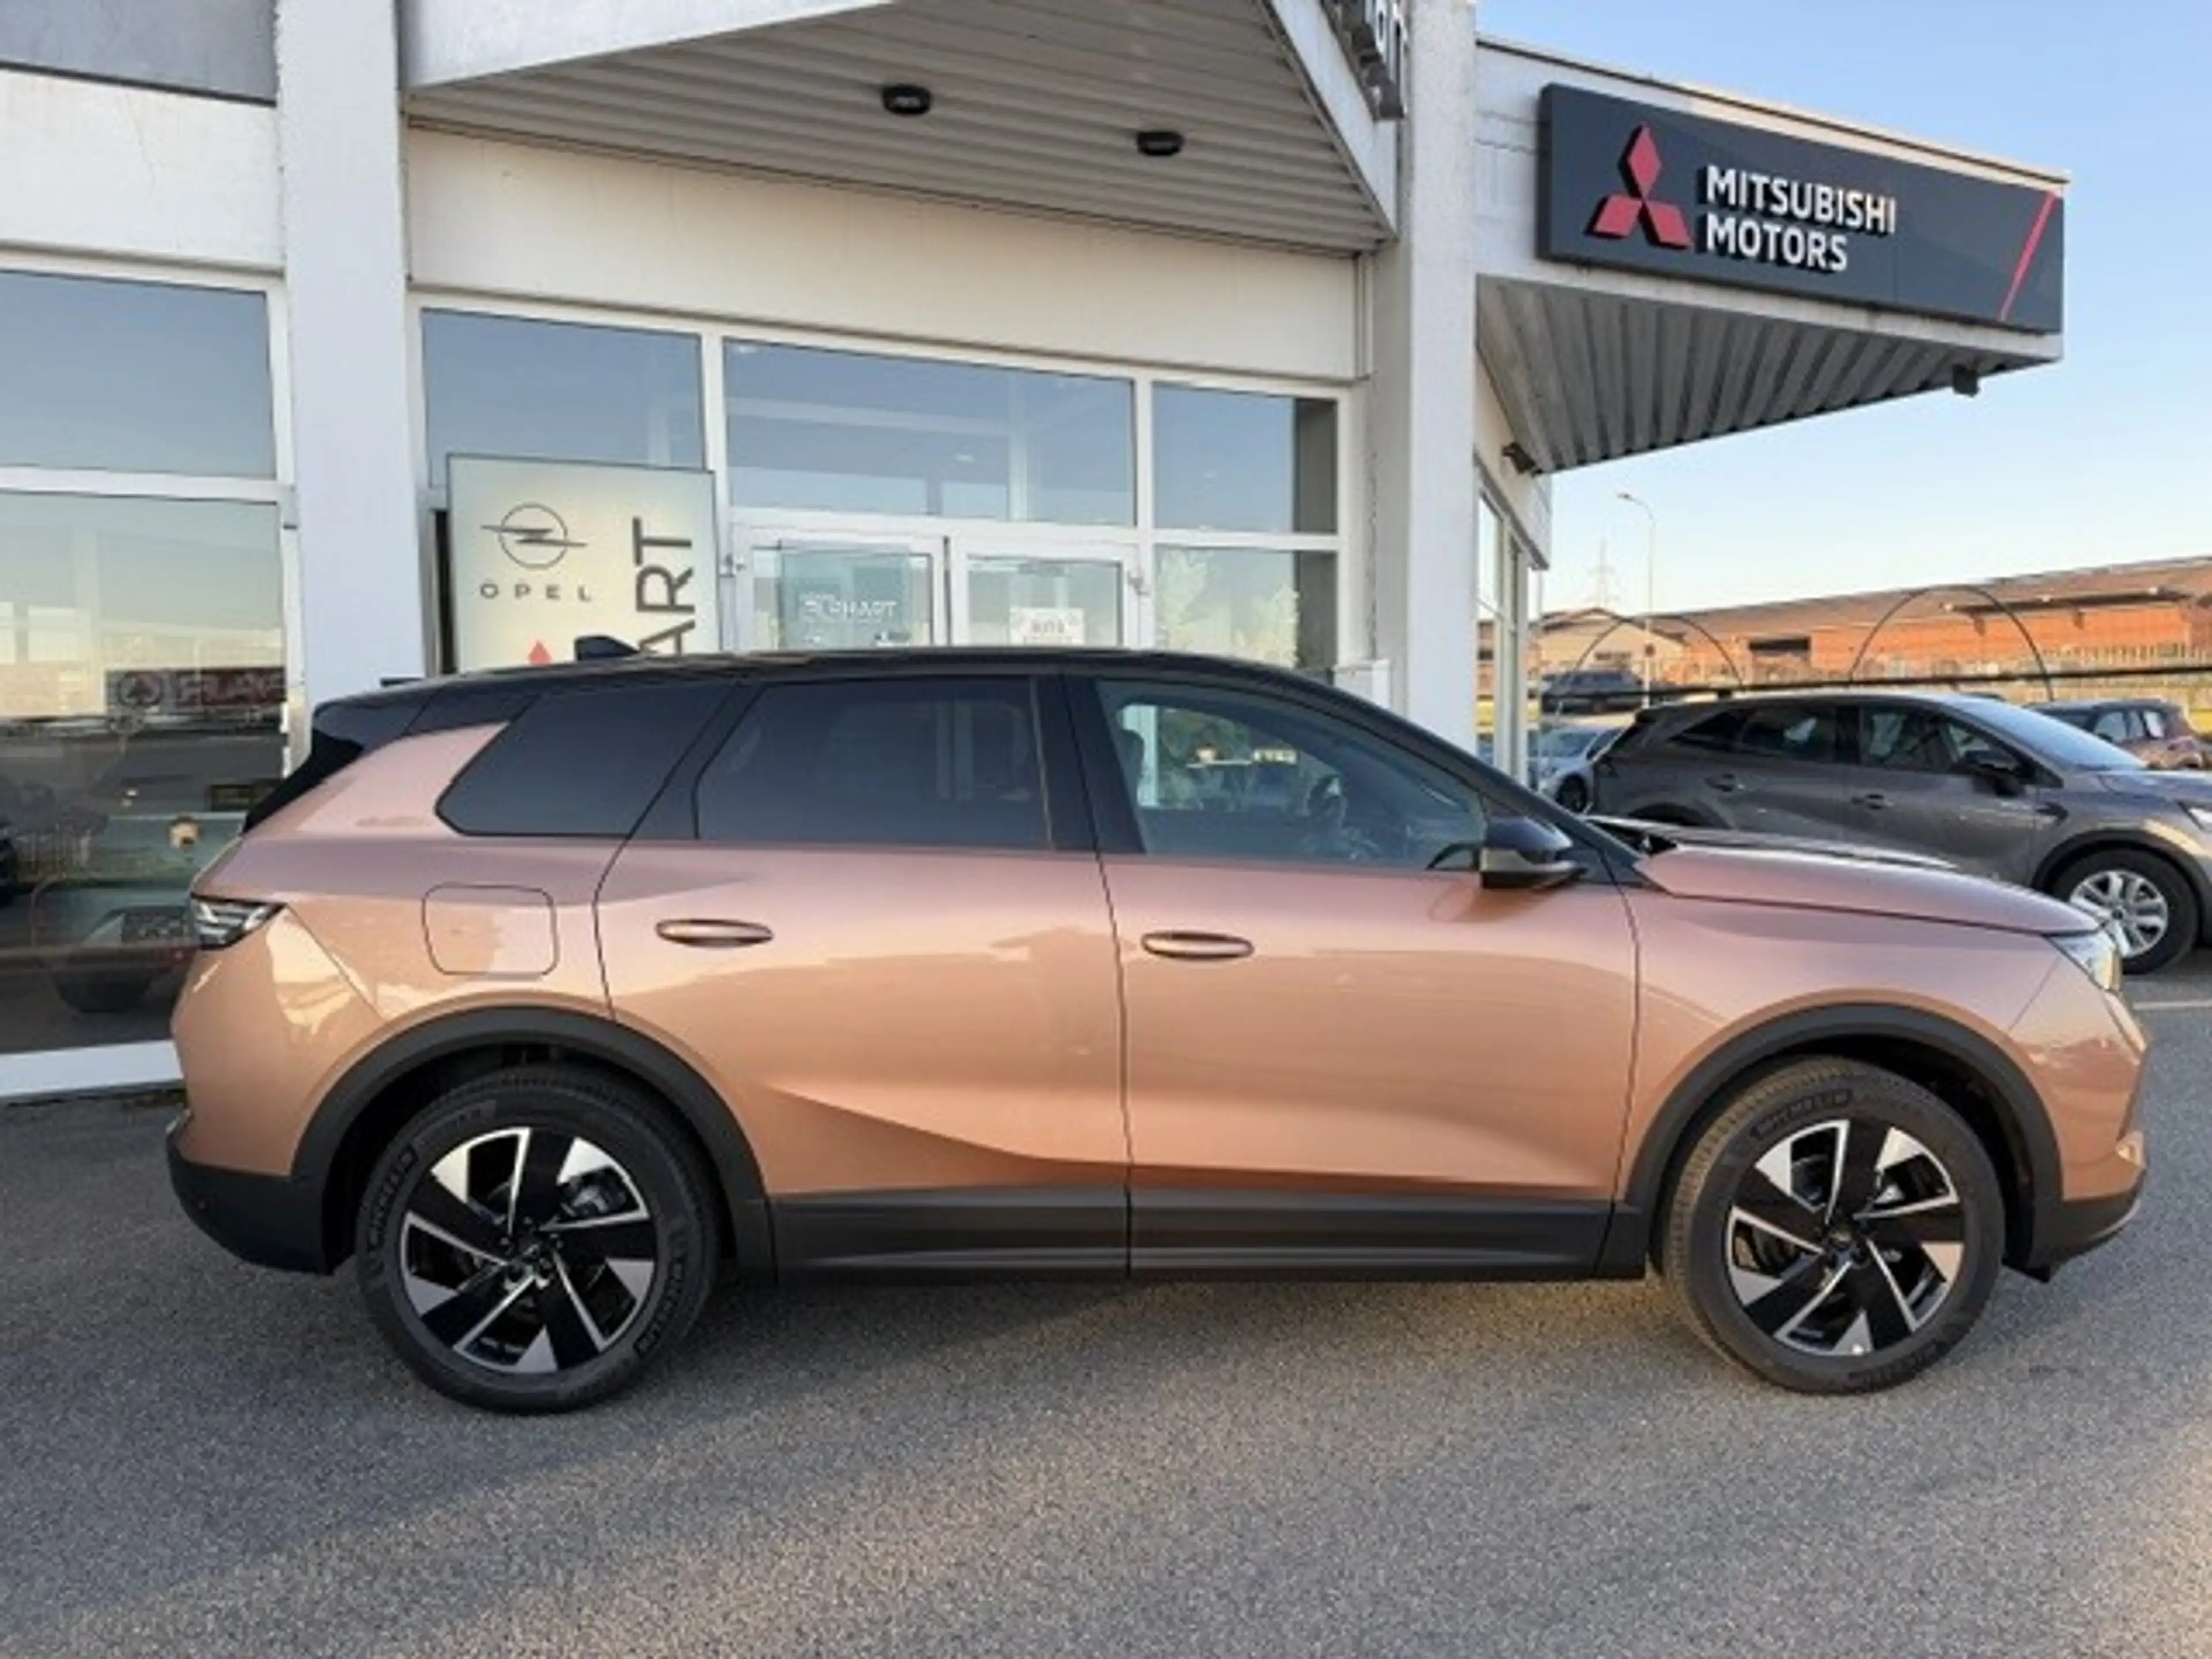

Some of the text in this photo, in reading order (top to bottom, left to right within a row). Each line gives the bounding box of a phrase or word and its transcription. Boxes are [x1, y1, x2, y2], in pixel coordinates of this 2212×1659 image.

[1705, 164, 1896, 234] MITSUBISHI
[1705, 214, 1849, 272] MOTORS
[480, 582, 592, 603] OPEL
